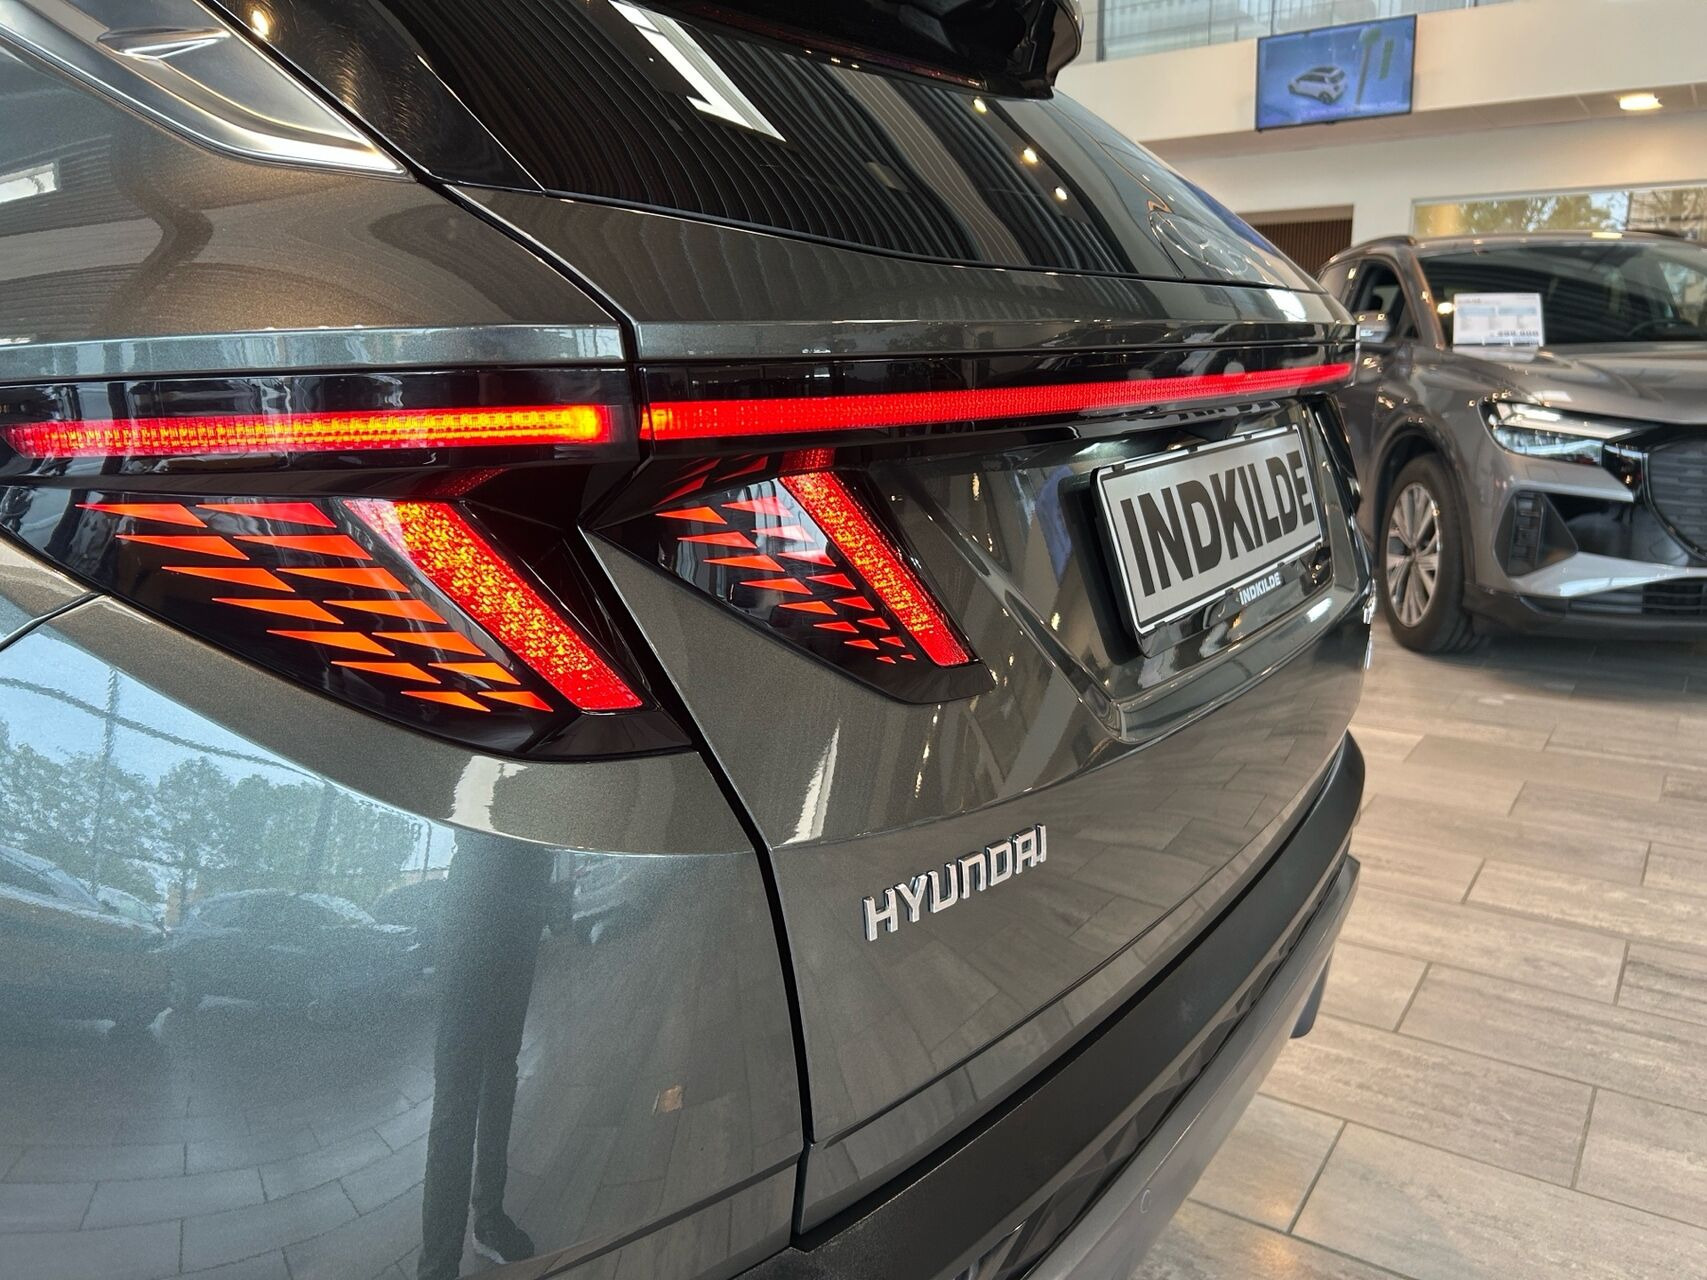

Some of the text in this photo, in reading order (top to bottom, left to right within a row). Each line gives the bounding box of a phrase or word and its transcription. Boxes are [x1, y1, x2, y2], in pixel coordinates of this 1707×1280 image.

[1120, 450, 1315, 598] INDKILDE
[1239, 572, 1281, 605] INDKILDE
[862, 824, 1047, 942] HYUNDAI
